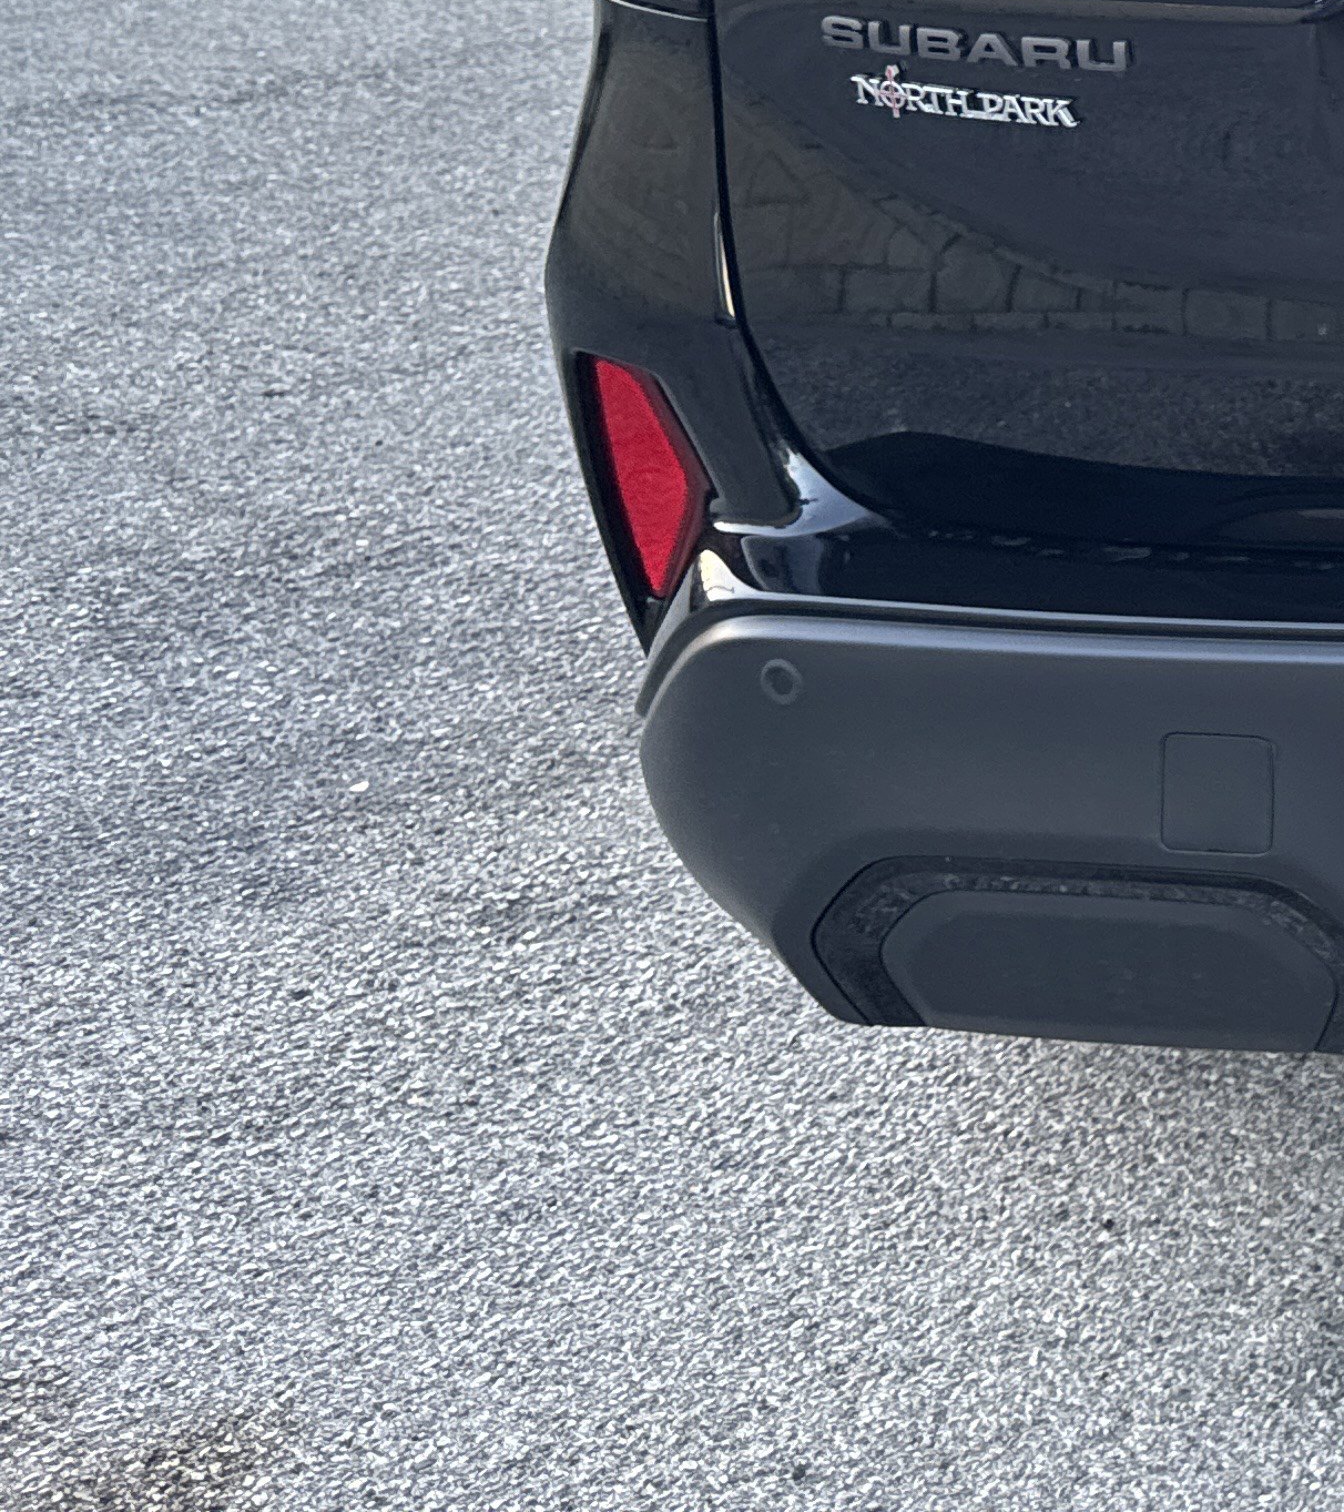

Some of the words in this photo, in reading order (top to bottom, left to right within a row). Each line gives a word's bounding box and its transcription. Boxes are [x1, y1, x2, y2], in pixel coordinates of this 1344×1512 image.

[820, 14, 1130, 73] SUBARU
[850, 71, 971, 118] NORTH
[972, 91, 1080, 129] PARK
